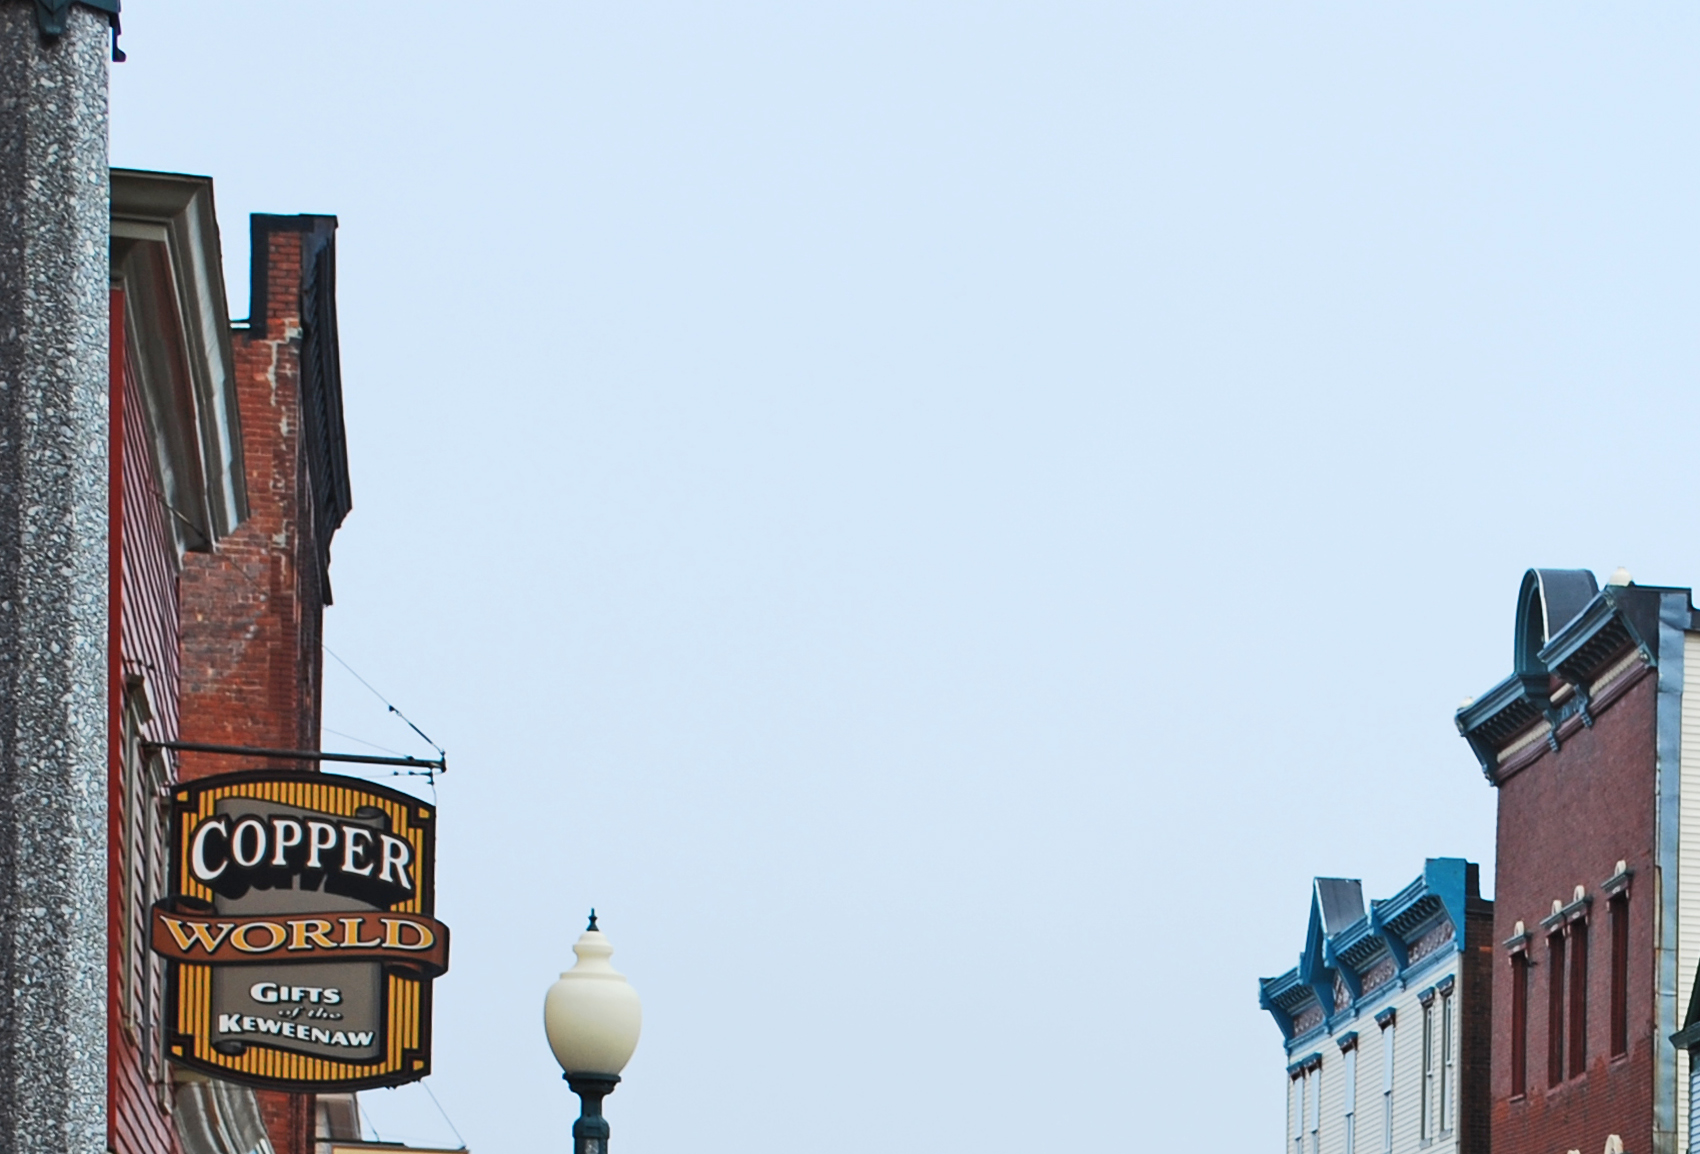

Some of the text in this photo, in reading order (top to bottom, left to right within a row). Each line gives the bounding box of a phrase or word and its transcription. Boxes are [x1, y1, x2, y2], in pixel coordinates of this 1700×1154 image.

[191, 818, 412, 891] COPPER
[160, 914, 435, 953] WORLD
[250, 982, 341, 1004] GIFTS
[218, 1013, 374, 1047] KEWEENAW
